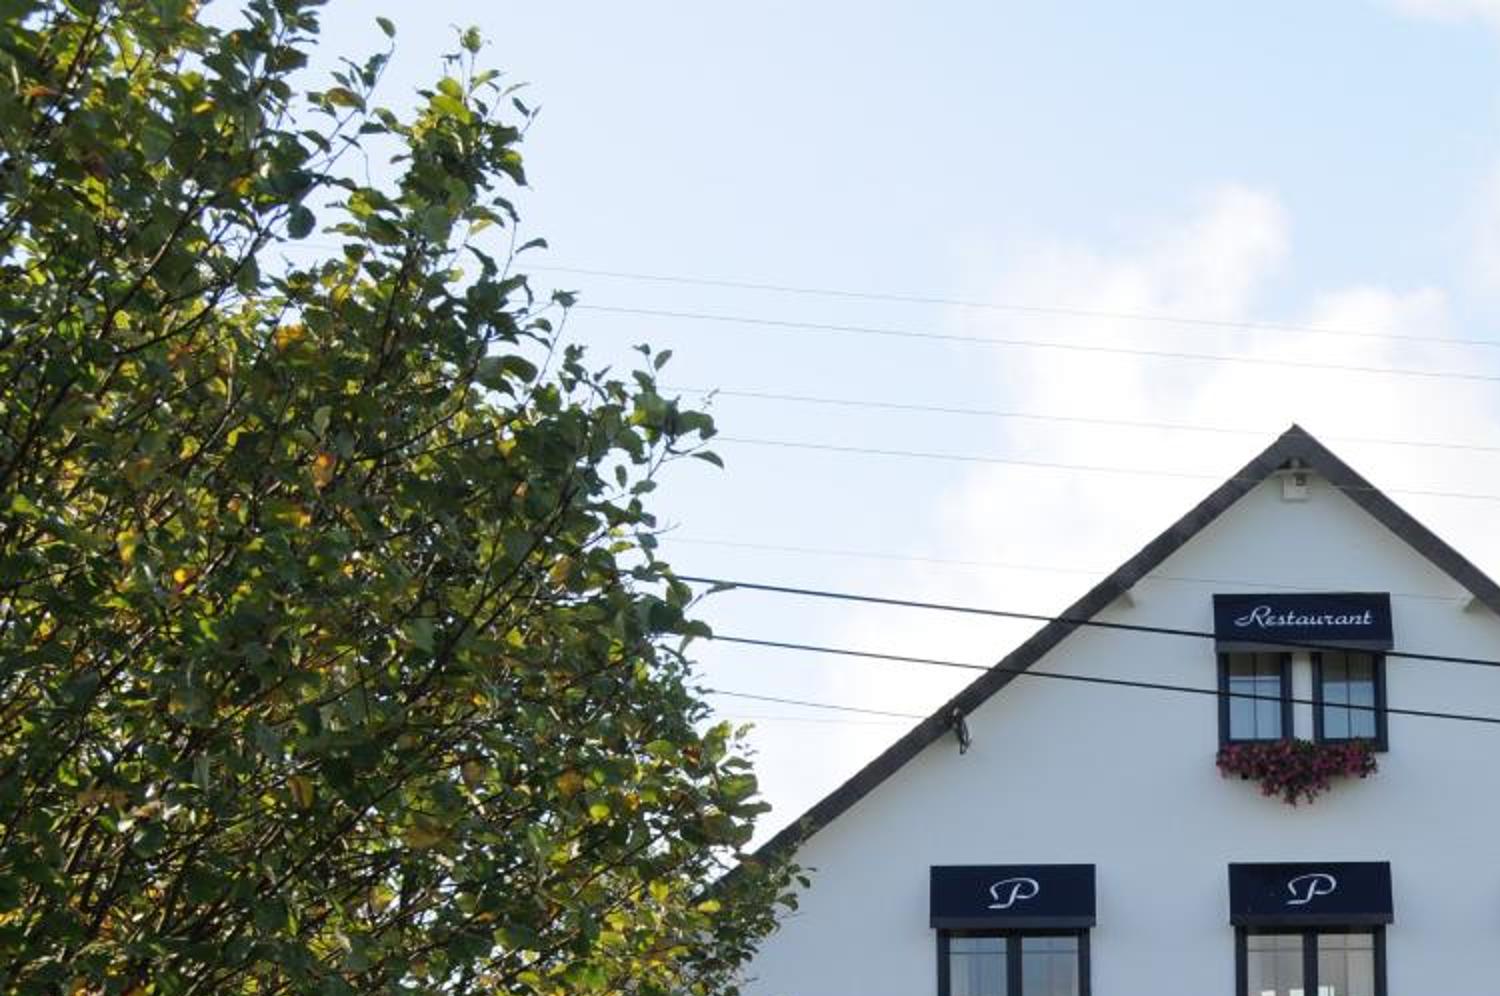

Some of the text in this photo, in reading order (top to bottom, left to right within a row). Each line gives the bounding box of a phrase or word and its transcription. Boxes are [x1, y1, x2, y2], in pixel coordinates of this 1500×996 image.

[1234, 605, 1373, 627] Restaurant
[987, 877, 1039, 909] P
[1286, 873, 1336, 905] P
